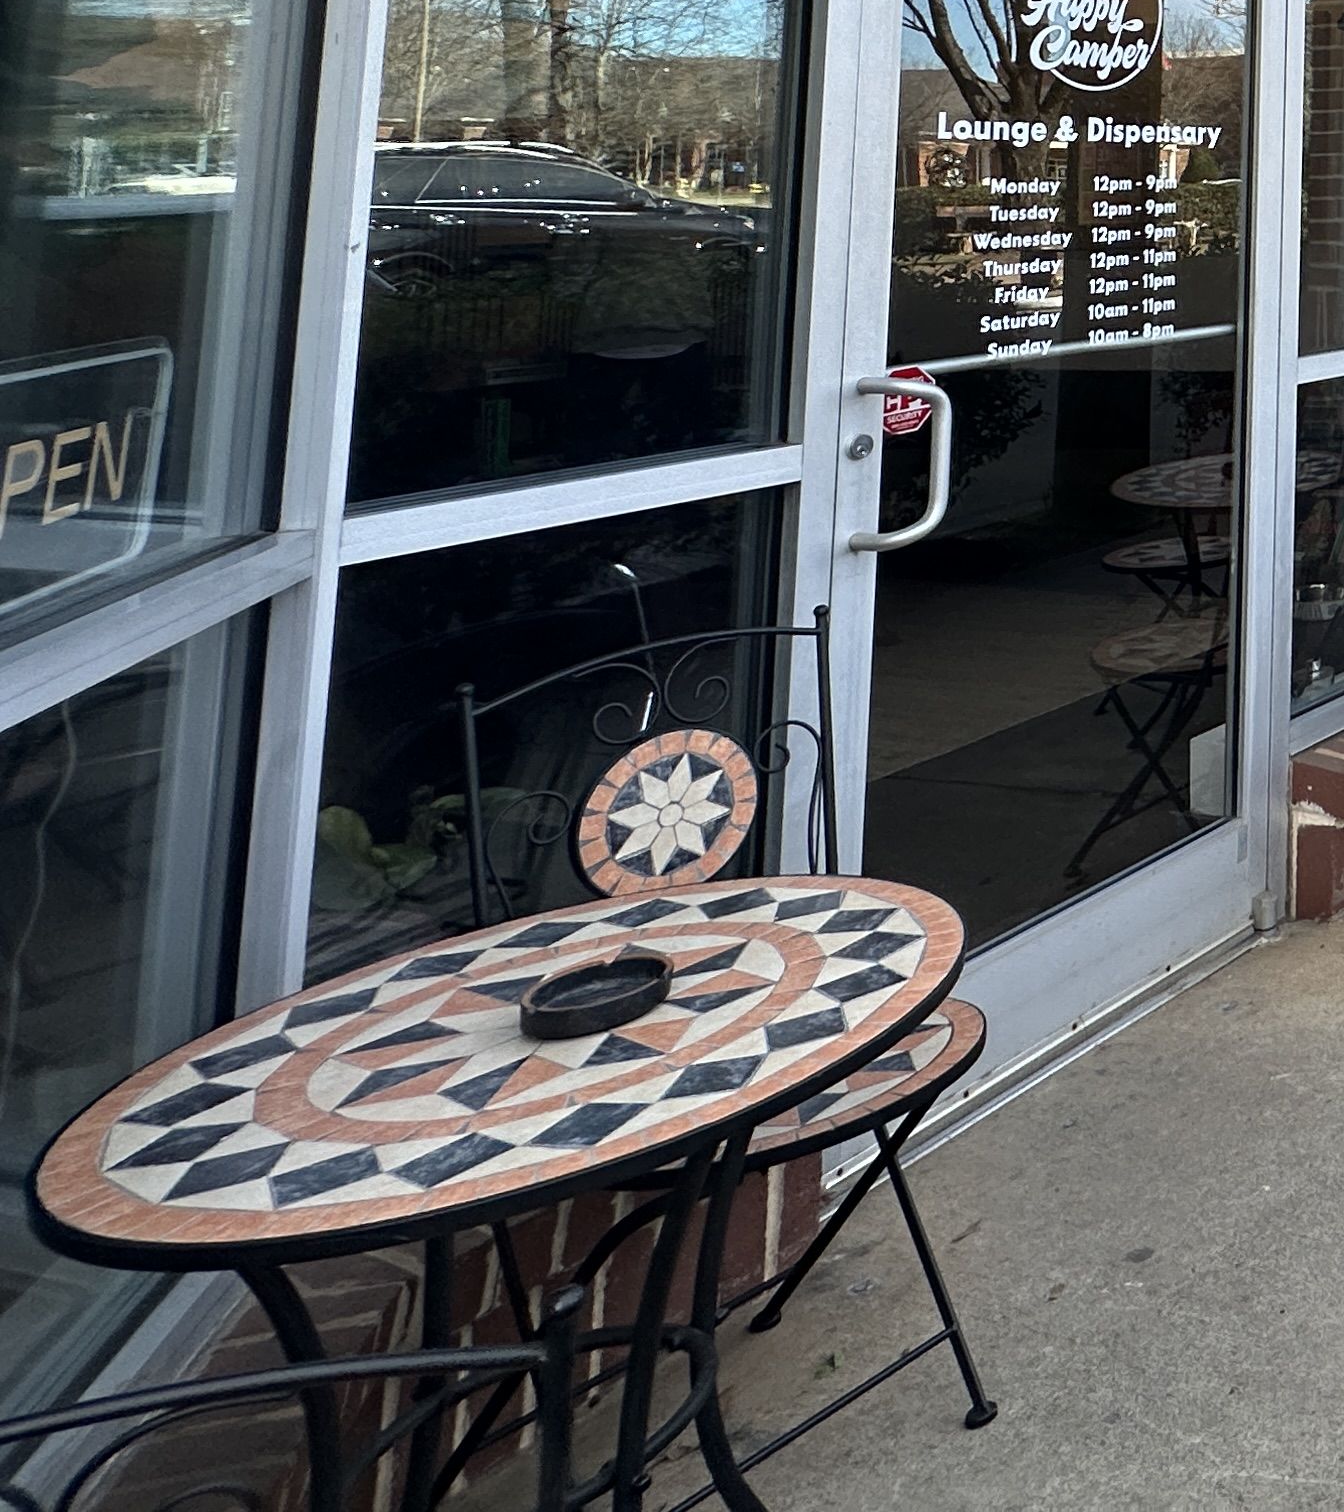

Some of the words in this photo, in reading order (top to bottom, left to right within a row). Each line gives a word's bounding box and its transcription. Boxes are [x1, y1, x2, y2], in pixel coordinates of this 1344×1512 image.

[1029, 25, 1152, 80] Camper
[938, 111, 1048, 148] Lounge
[1055, 115, 1079, 143] &
[1087, 116, 1223, 149] Dispensary
[990, 177, 1060, 196] Monday
[1093, 175, 1132, 192] 12pm
[1146, 175, 1177, 192] 9pm
[989, 205, 1059, 223] Tuesday
[1092, 201, 1132, 218] 12pm
[1145, 199, 1176, 217] 9pm
[973, 231, 1073, 250] Wednesday
[1091, 226, 1131, 244] 12pm
[1144, 224, 1176, 241] 9pm
[983, 258, 1062, 277] Thursday
[1090, 252, 1130, 270] 12pm
[1142, 248, 1176, 266] 11pm
[994, 286, 1049, 304] Friday
[1089, 278, 1129, 296] 12pm
[1142, 273, 1176, 290] 11pm
[980, 311, 1061, 333] Saturday
[1087, 303, 1129, 321] 10am
[1142, 298, 1176, 316] 11pm
[987, 338, 1053, 359] Sunday
[1088, 329, 1129, 346] 10am
[1143, 323, 1175, 340] 8pm
